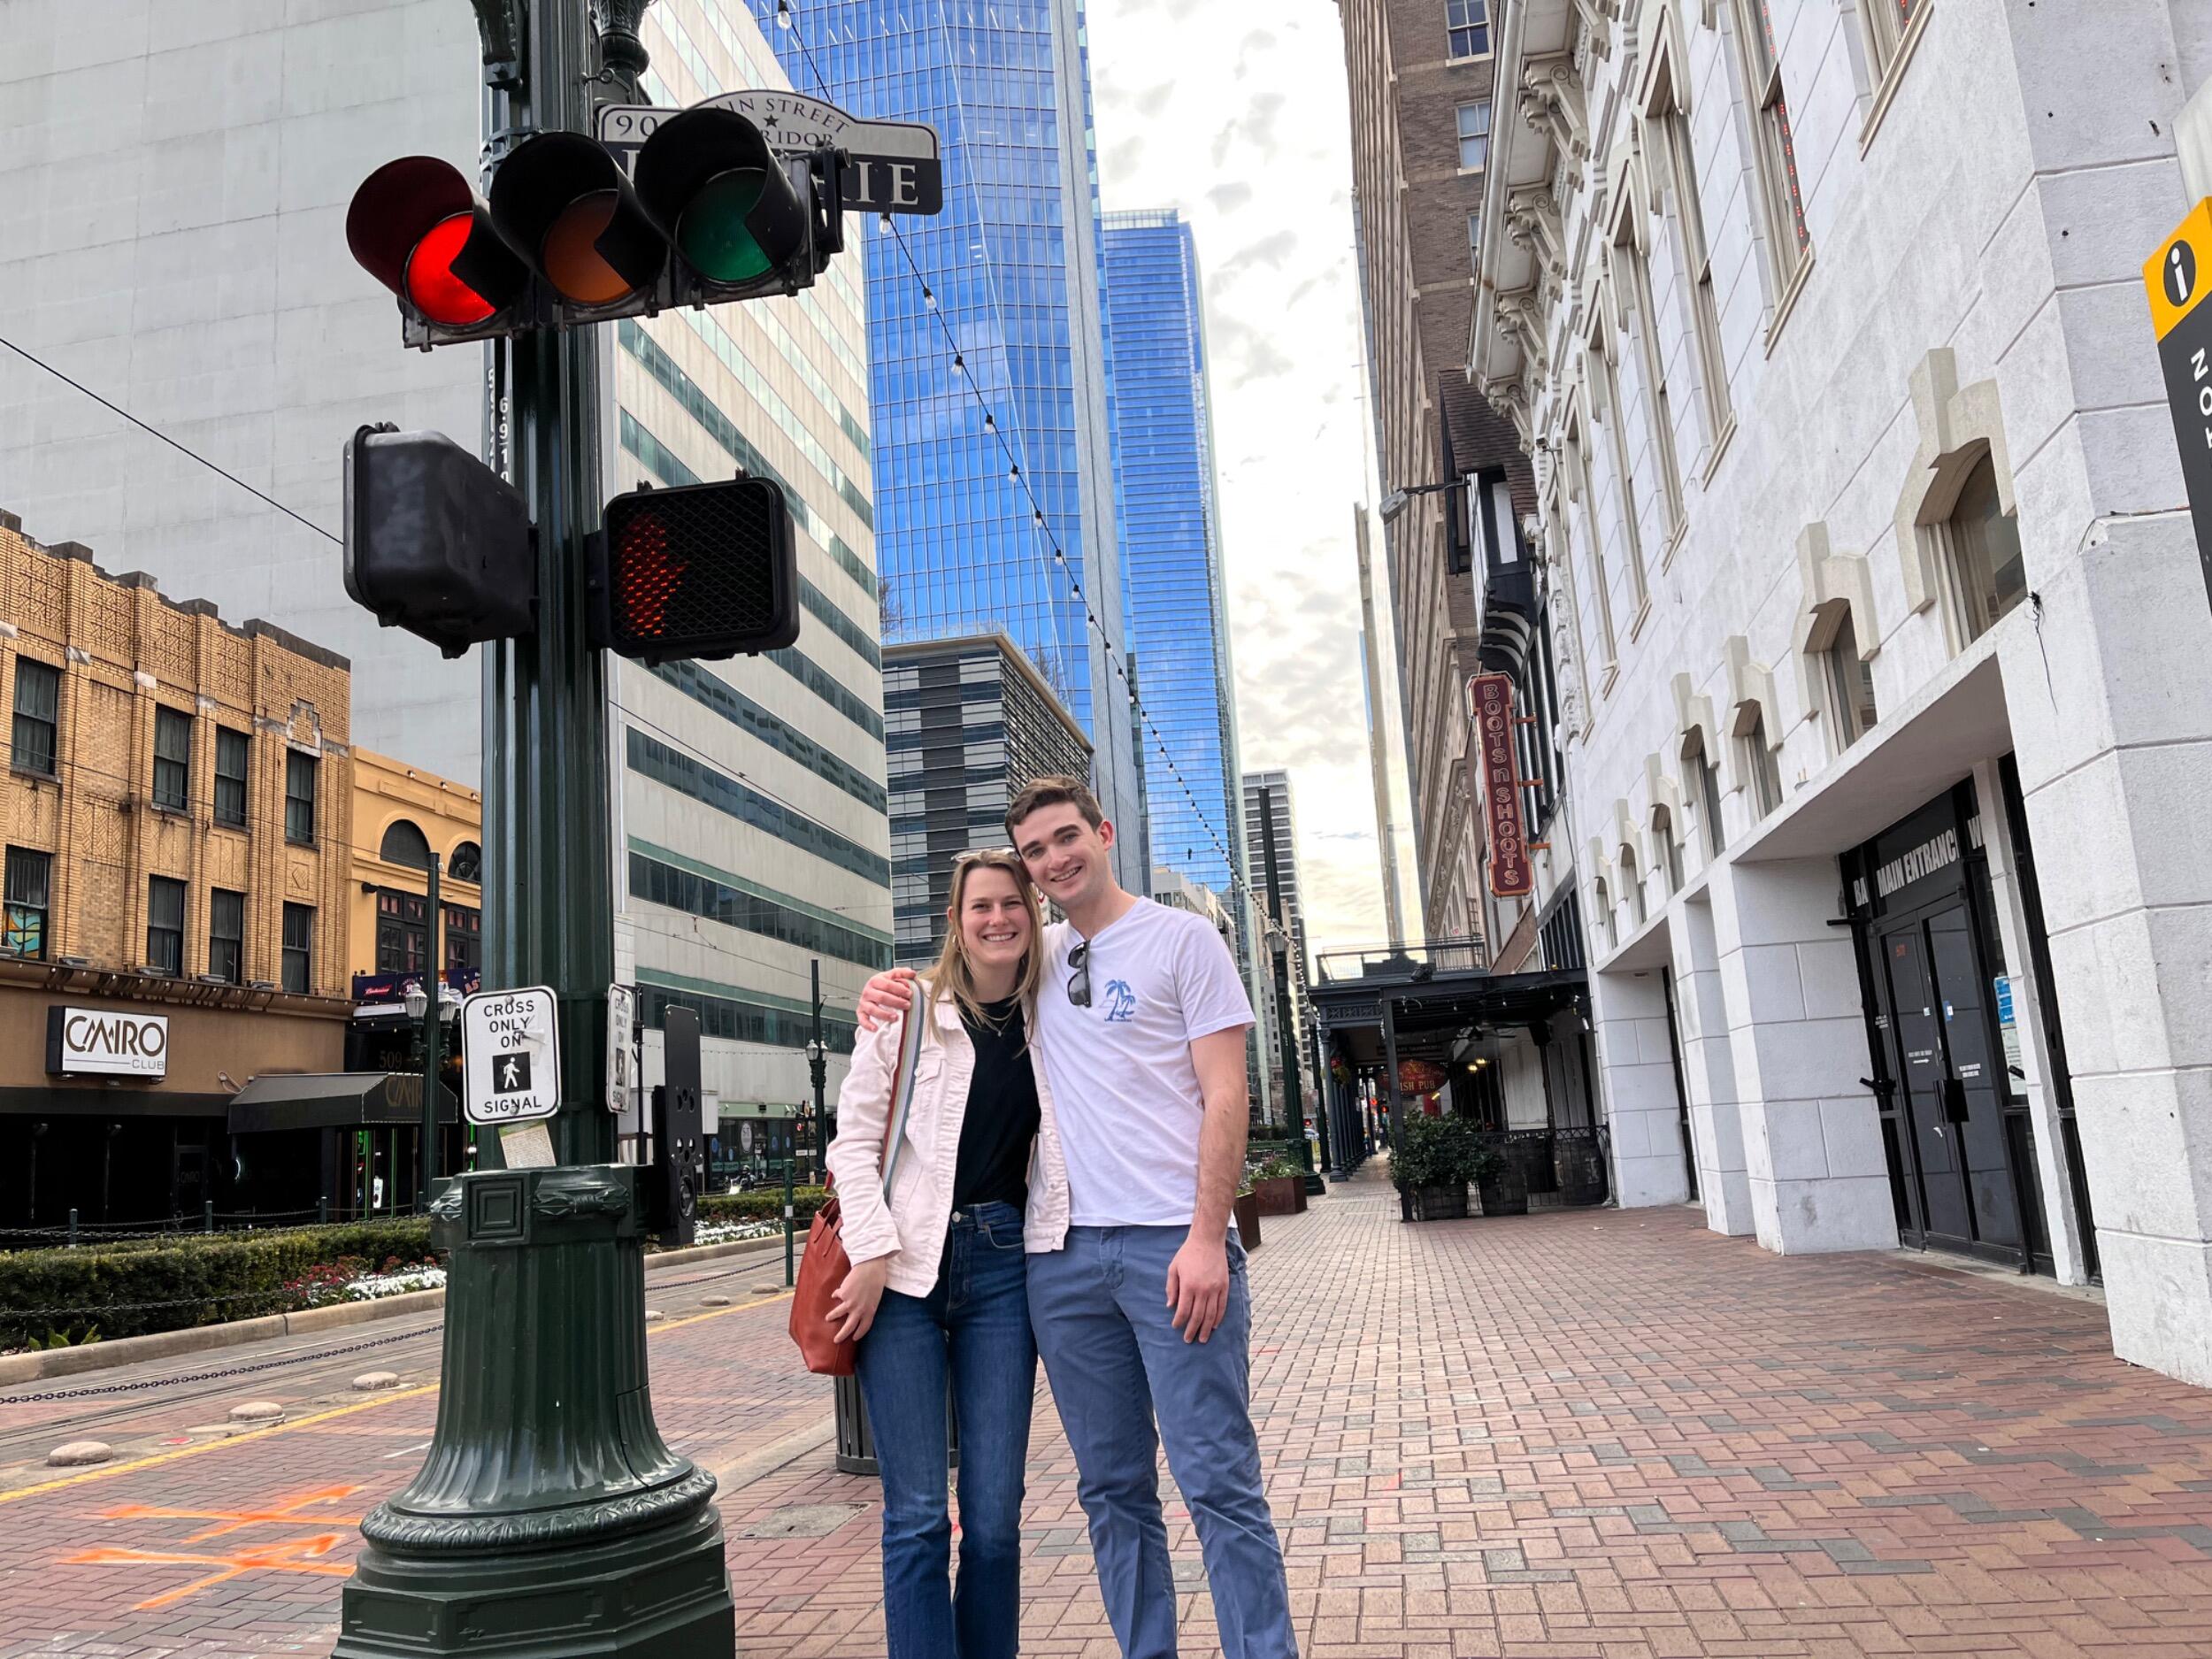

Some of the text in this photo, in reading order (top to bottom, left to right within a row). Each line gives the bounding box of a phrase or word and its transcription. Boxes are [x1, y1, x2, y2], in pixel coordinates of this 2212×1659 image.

[765, 98, 850, 134] STREET
[616, 115, 658, 137] 90
[760, 129, 834, 145] RIDOR
[1483, 684, 1507, 764] BOOTS
[1495, 787, 1519, 886] SHOOTS
[1876, 858, 1905, 897] MAIN
[483, 1000, 535, 1017] CROSS
[489, 1017, 531, 1033] ONLY
[65, 1015, 165, 1057] CAIRO
[501, 1035, 522, 1048] ON
[132, 1059, 165, 1070] CLUB
[1400, 1079, 1435, 1091] ISH PUB
[484, 1095, 542, 1114] SIGNAL
